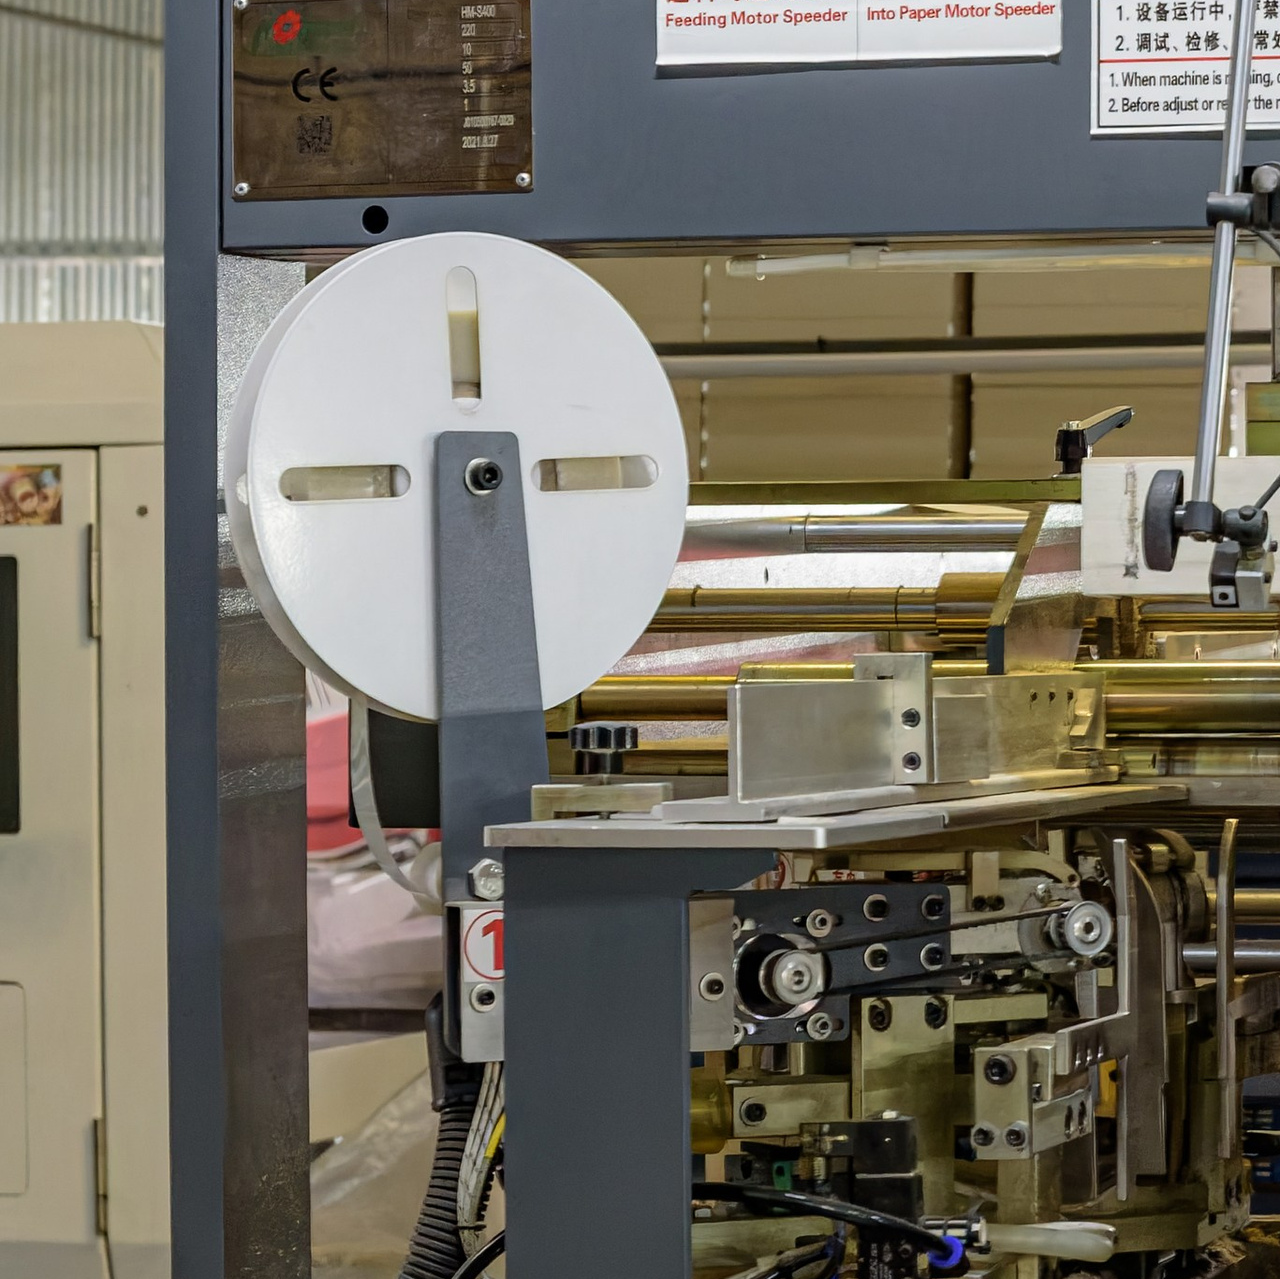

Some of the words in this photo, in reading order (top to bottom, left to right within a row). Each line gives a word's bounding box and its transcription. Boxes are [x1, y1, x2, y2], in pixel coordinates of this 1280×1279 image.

[461, 5, 496, 19] HM-S400
[665, 12, 727, 30] Feeding
[731, 10, 779, 26] Motor
[783, 8, 849, 27] Speeder
[867, 6, 896, 21] Into
[900, 4, 942, 22] Paper
[944, 2, 991, 19] Motor
[994, 0, 1056, 20] Speeder
[1116, 5, 1130, 21] 1.
[461, 23, 476, 36] 220
[462, 43, 472, 56] 10
[1115, 35, 1130, 52] 2.
[291, 66, 338, 103] CE
[1109, 73, 1119, 87] 1.
[1121, 71, 1157, 87] When
[1159, 70, 1210, 87] machine
[1212, 70, 1222, 85] is
[1225, 69, 1274, 88] ring,
[1108, 98, 1118, 113] 2.
[1122, 96, 1159, 112] Before
[1162, 95, 1199, 115] adjust
[1201, 99, 1214, 111] or
[1254, 95, 1273, 110] the
[482, 919, 504, 971] 1
